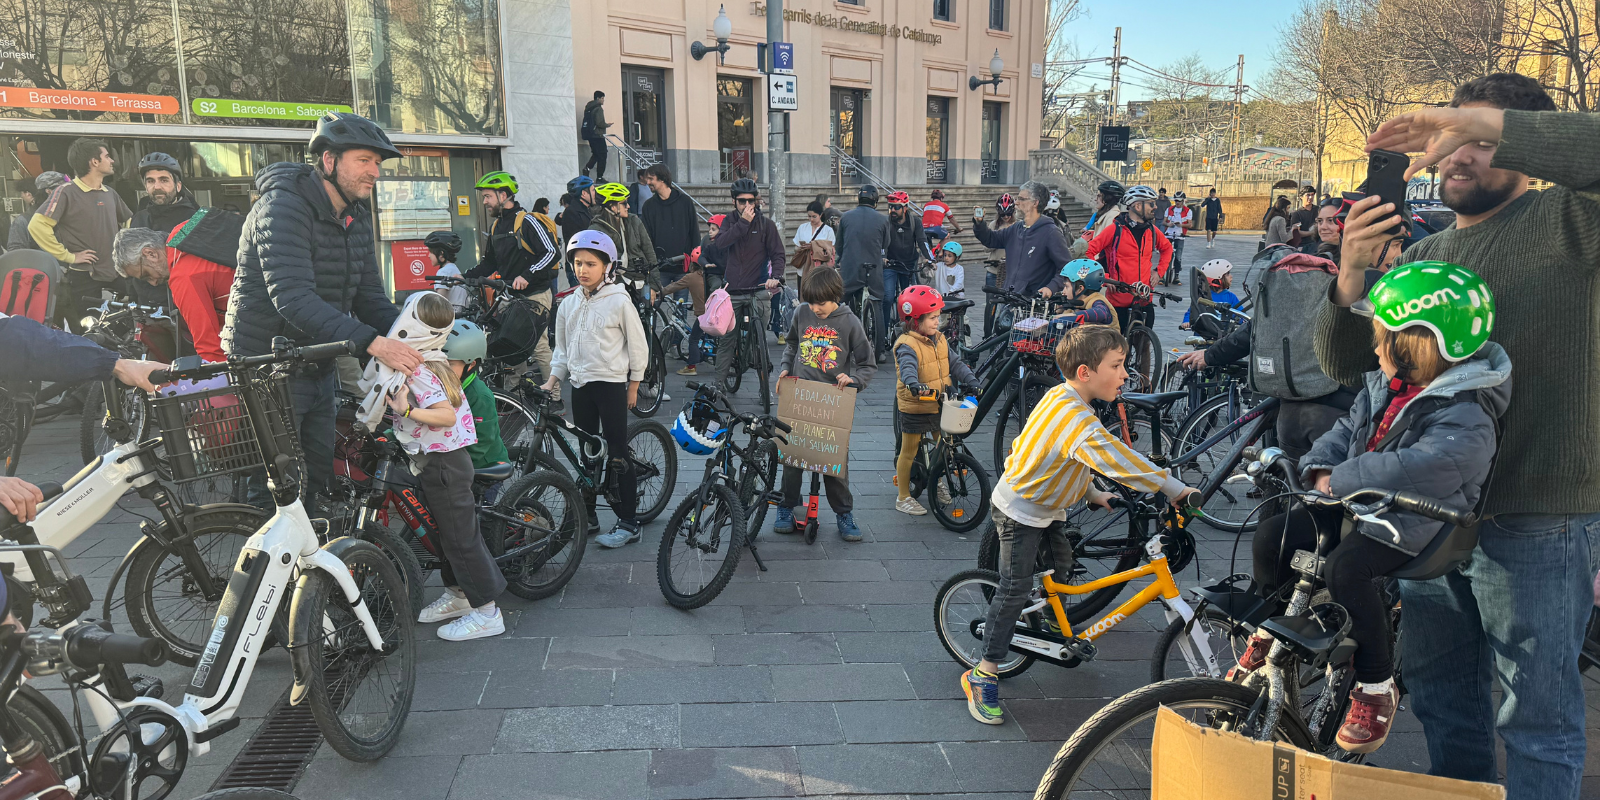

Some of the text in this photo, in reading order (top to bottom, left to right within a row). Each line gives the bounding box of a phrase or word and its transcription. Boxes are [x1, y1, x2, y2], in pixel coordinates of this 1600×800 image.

[814, 12, 827, 26] de
[840, 16, 887, 36] Generalitat
[890, 24, 901, 38] de
[903, 26, 942, 46] Catalunya
[29, 91, 98, 106] Barcelona
[109, 96, 162, 110] Terrassa
[200, 101, 218, 113] S2
[232, 102, 286, 116] Barcelona
[1386, 287, 1461, 321] woom
[790, 421, 836, 441] EL PLANETA
[809, 440, 840, 454] SALVANT
[1084, 612, 1127, 638] woom
[1298, 764, 1306, 785] seat
[1277, 775, 1289, 800] UP
